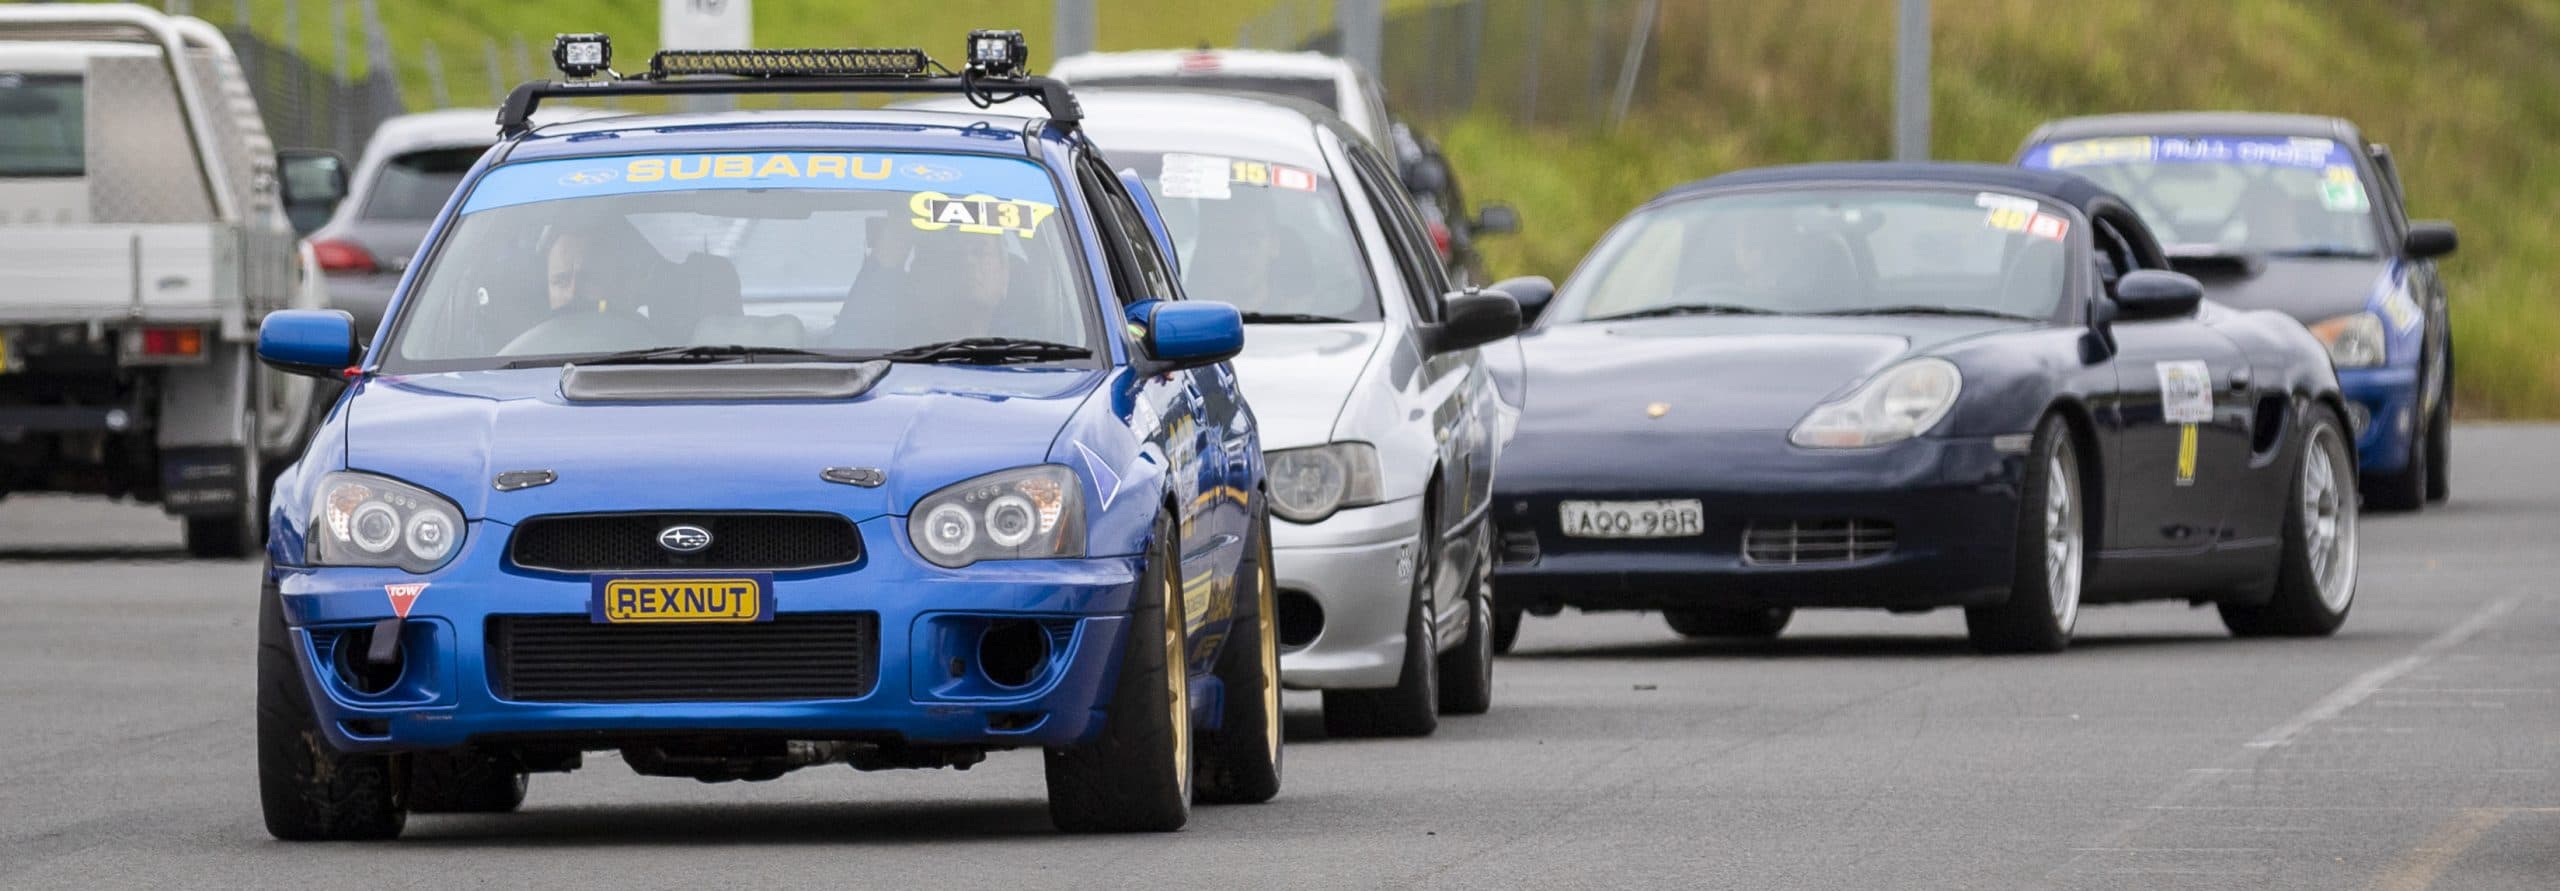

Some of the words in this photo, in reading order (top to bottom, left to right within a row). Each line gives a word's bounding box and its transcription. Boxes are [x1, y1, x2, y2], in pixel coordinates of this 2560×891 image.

[626, 154, 893, 182] SUBARU
[1231, 160, 1268, 185] 15
[937, 202, 976, 224] A
[997, 203, 1020, 228] 3
[389, 585, 421, 597] TOW
[617, 588, 747, 613] REXNUT
